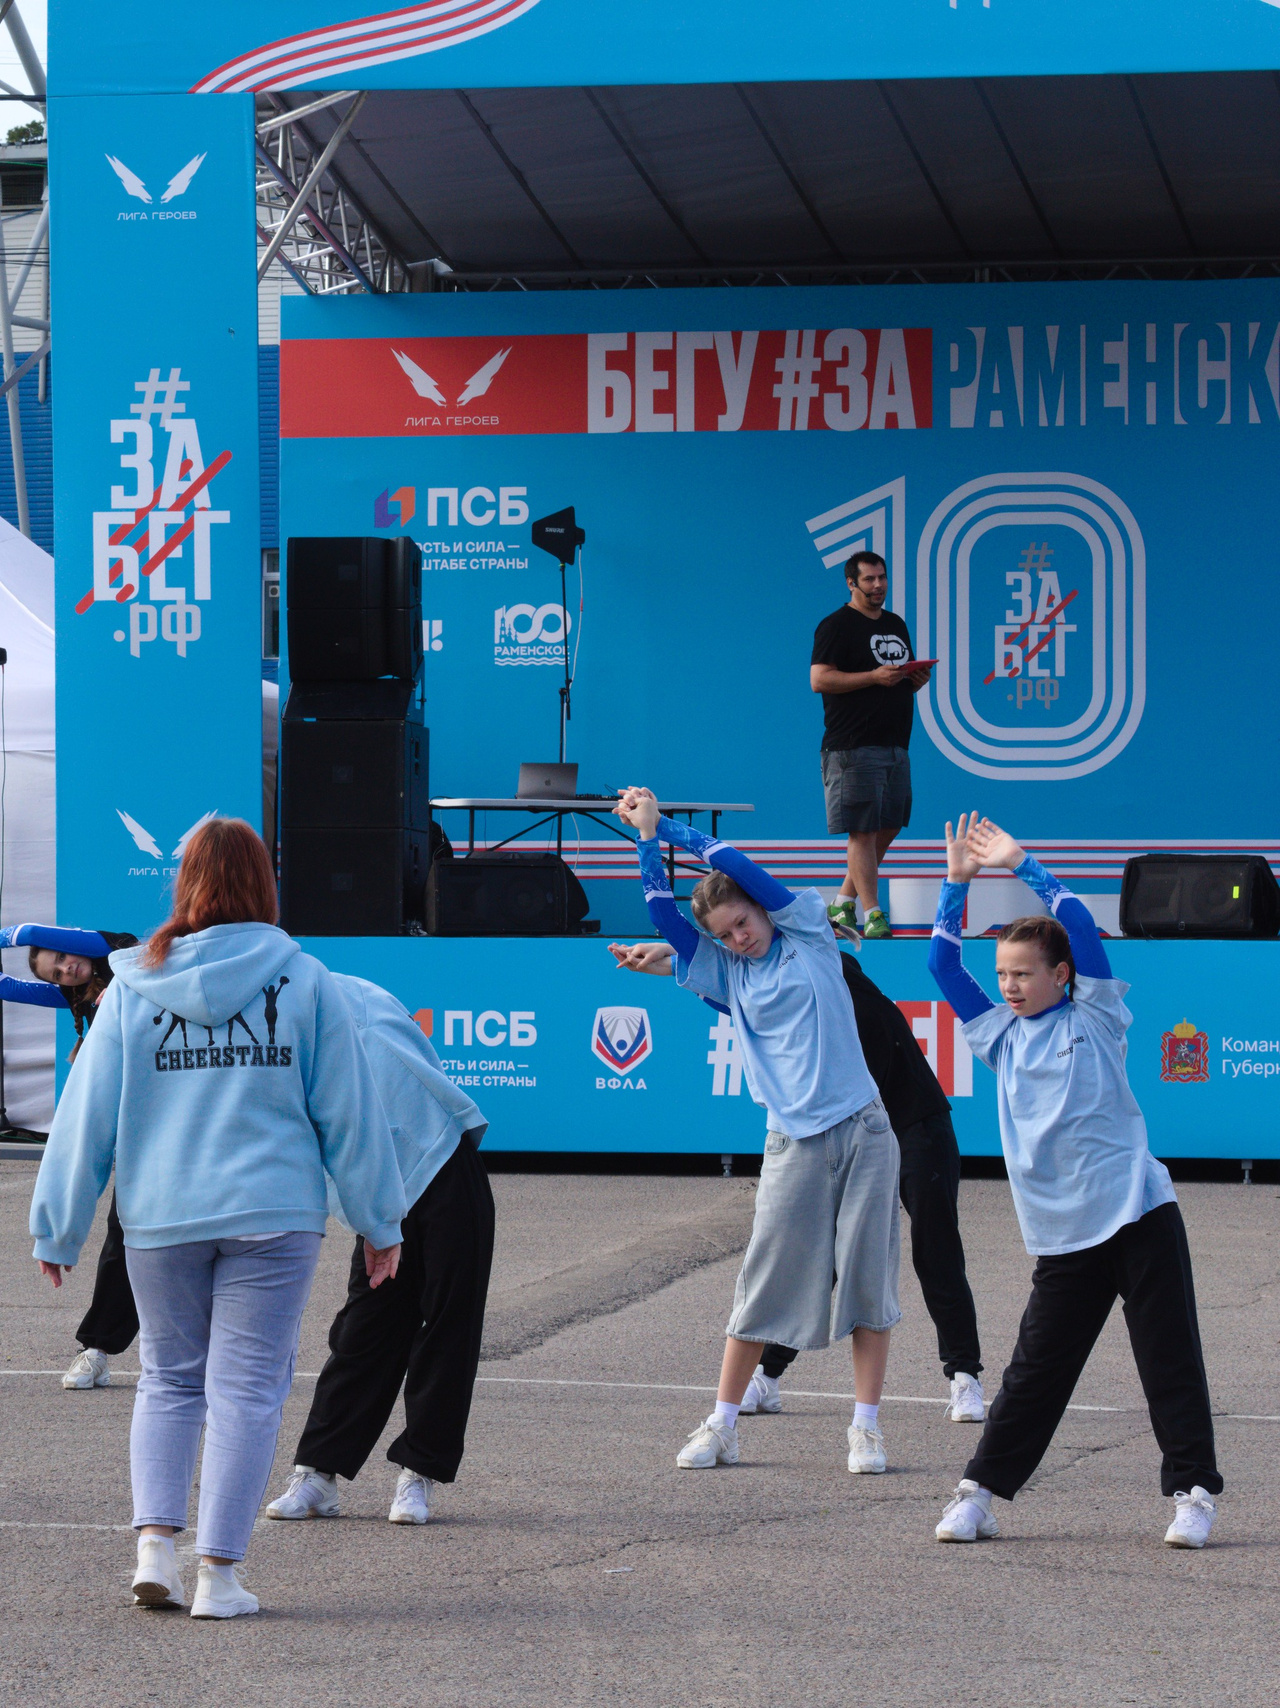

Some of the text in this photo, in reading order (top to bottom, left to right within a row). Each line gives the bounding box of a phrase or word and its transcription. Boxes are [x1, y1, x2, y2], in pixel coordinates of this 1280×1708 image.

[116, 210, 198, 221] ЛИГА ГЕРОЕВ
[587, 330, 759, 434] БЕГУ
[773, 328, 918, 432] #ЗА
[404, 414, 500, 427] ЛИГА ГЕРОЕВ
[110, 419, 211, 509] ЗА
[427, 486, 530, 527] ПСБ
[93, 510, 231, 601] БЕГ
[453, 541, 463, 553] И
[465, 541, 506, 553] СИЛА
[469, 558, 529, 570] СТРАНЫ
[1005, 571, 1067, 624] ЗА
[494, 603, 572, 644] 100
[494, 645, 571, 656] РАМЕНСКОЕ
[994, 624, 1078, 678] БЕГ
[127, 867, 159, 876] ЛИГА
[444, 1010, 538, 1047] ПСБ
[154, 1045, 293, 1072] CHEERSTARS
[467, 1060, 477, 1071] И
[479, 1060, 516, 1071] СИЛА
[482, 1076, 537, 1087] СТРАНЫ
[595, 1077, 648, 1090] ВФЛА
